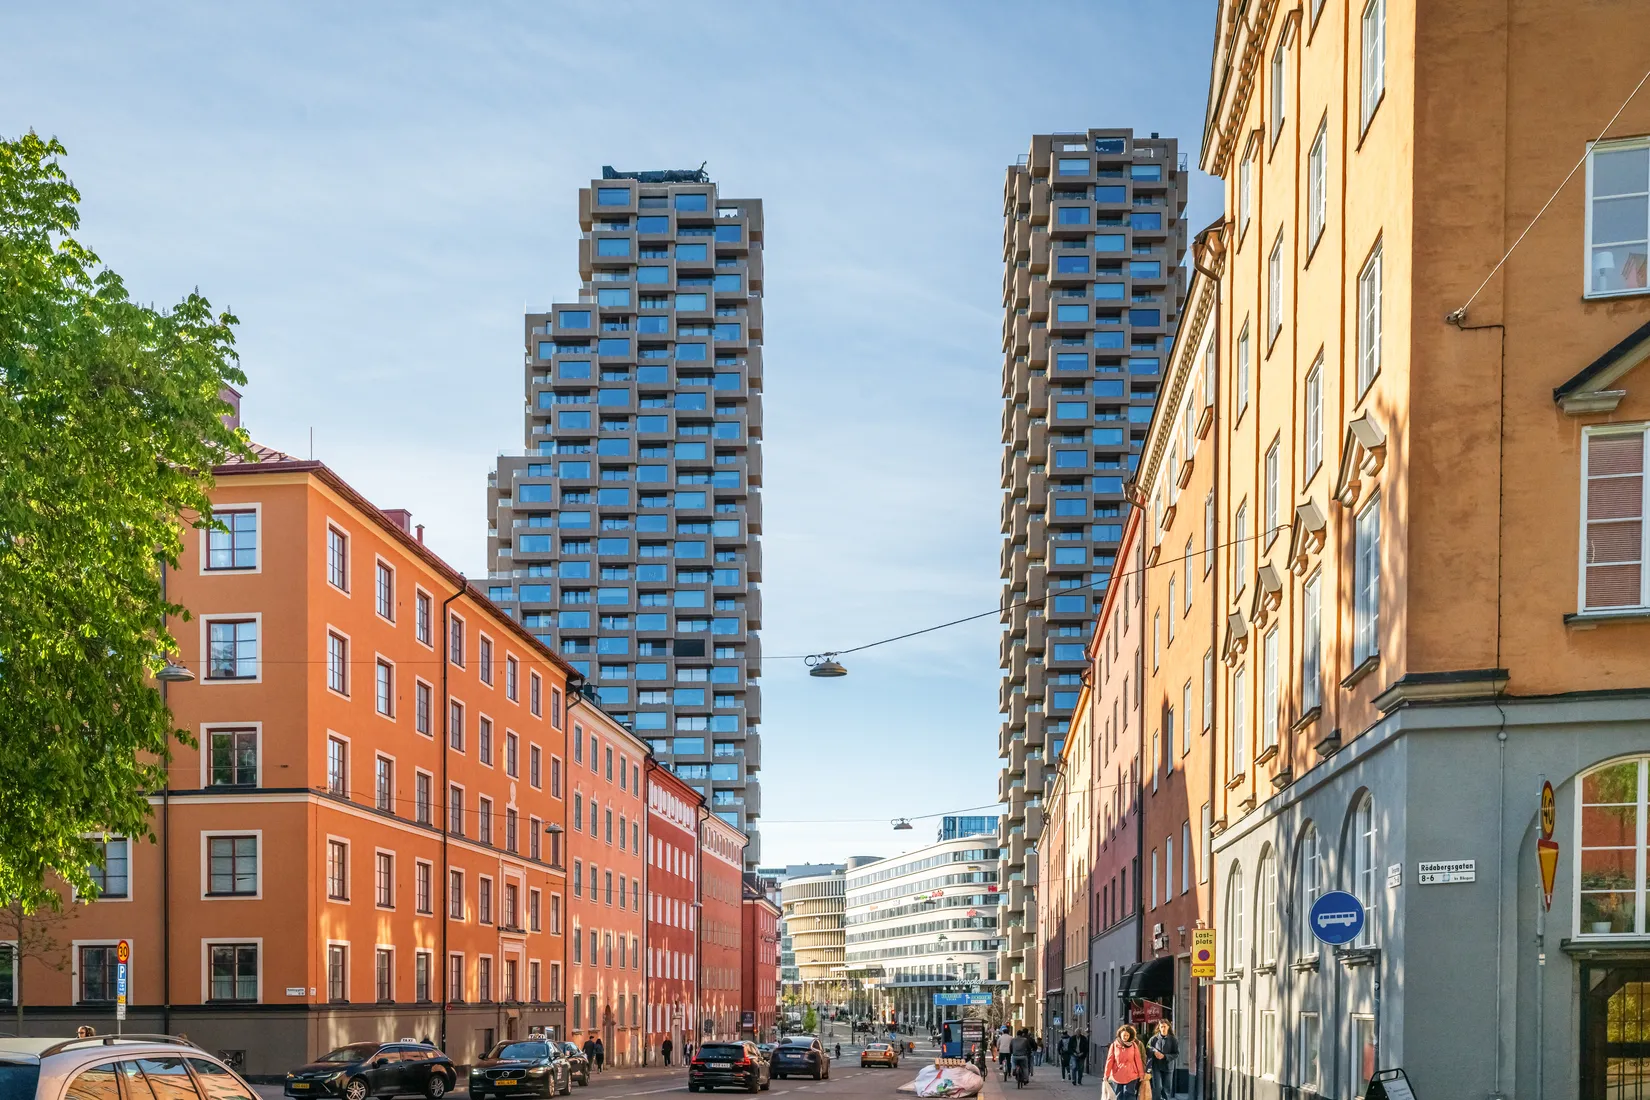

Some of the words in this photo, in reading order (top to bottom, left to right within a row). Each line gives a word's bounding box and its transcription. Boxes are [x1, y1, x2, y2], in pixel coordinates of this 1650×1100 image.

[1543, 795, 1553, 825] 40
[1421, 863, 1473, 872] Rödabergsgatan
[119, 946, 128, 957] 30
[119, 966, 125, 978] P
